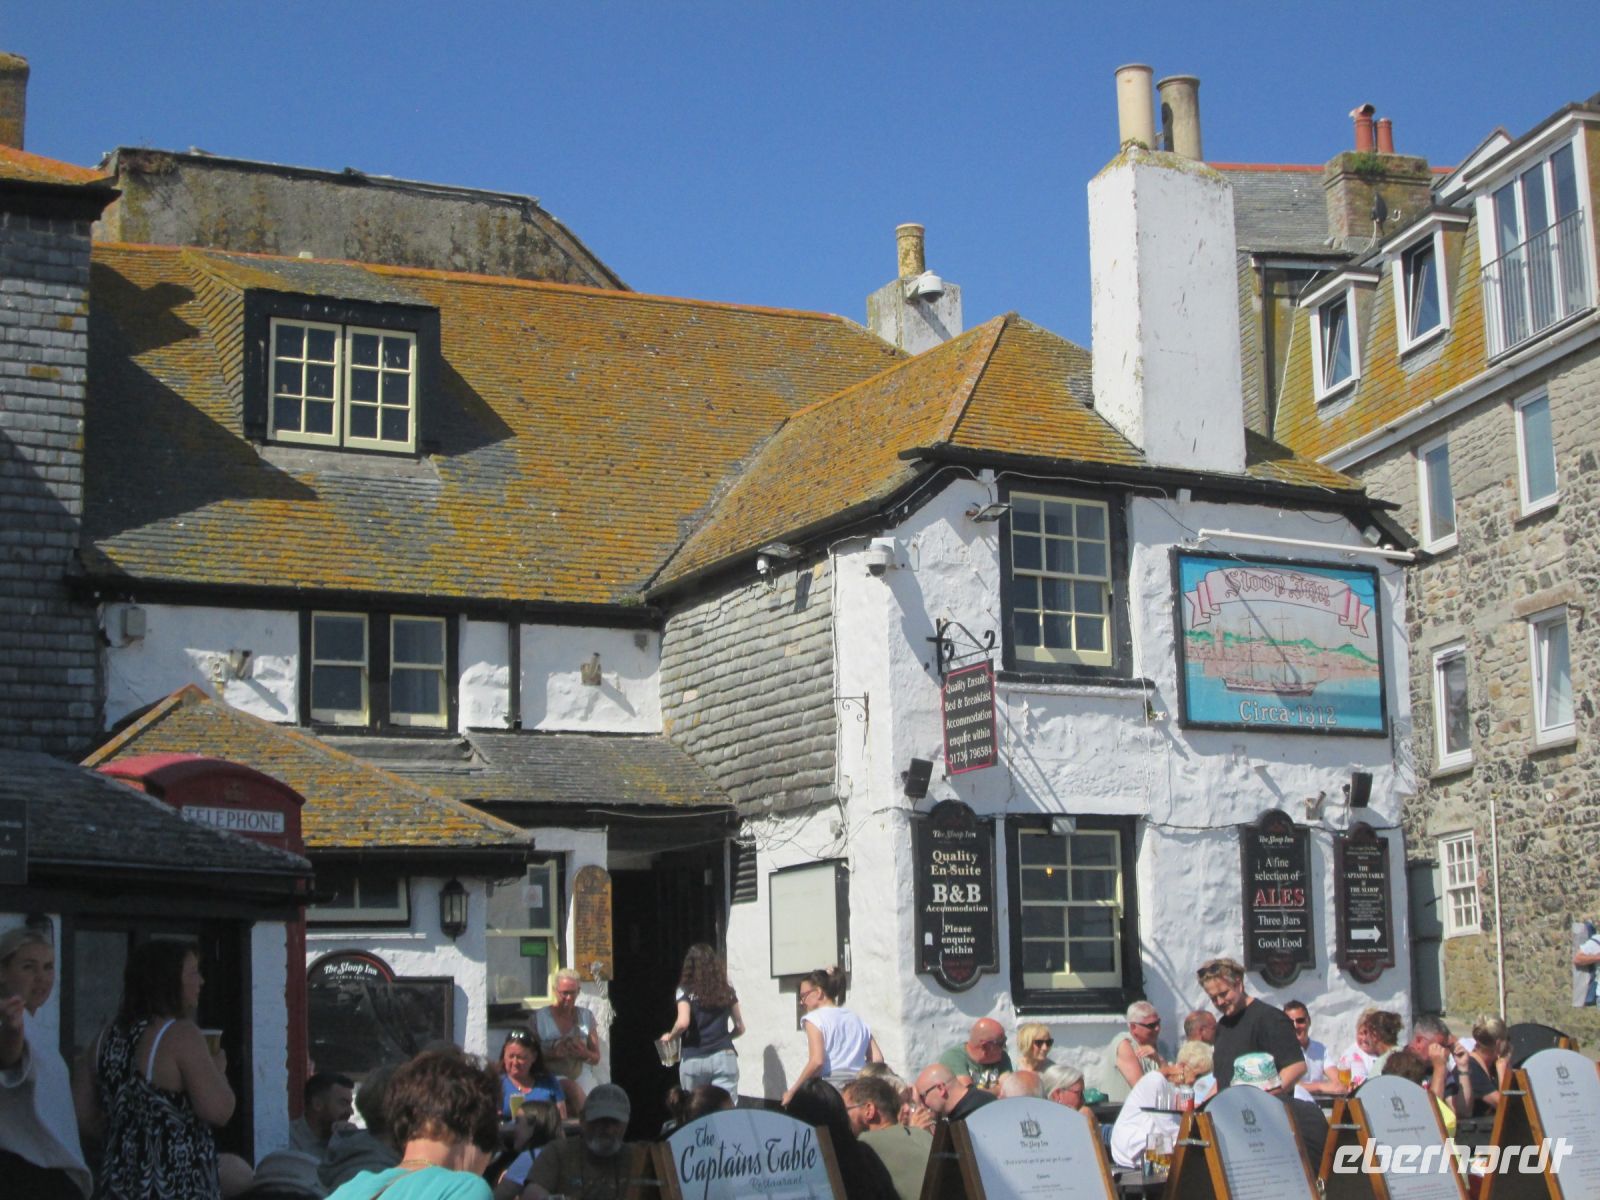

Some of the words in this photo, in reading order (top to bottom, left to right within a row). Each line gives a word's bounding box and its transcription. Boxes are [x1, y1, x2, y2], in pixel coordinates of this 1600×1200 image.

[1225, 569, 1285, 598] Sloop
[1289, 573, 1331, 606] Inn
[945, 680, 966, 694] Quality
[945, 699, 956, 712] Bed
[957, 698, 963, 709] &
[964, 691, 991, 707] Breakfast
[946, 710, 993, 730] Accommodation
[1239, 701, 1290, 722] Circa
[1296, 705, 1337, 725] 1312
[949, 731, 971, 748] enquire
[972, 728, 991, 741] within
[185, 808, 280, 830] TELEPHONE
[932, 850, 978, 864] Quality
[1265, 858, 1274, 867] A
[1275, 857, 1289, 867] fine
[930, 865, 982, 876] En-Suite
[1255, 871, 1288, 882] selection
[1290, 871, 1300, 881] of
[932, 883, 981, 903] B&B
[1253, 888, 1305, 907] ALES
[926, 904, 988, 913] Accommodation
[1258, 915, 1281, 926] Three
[1283, 915, 1301, 926] Bars
[944, 924, 972, 934] Please
[941, 936, 976, 946] enquire
[1258, 937, 1280, 949] Good
[1282, 937, 1302, 949] Food
[944, 945, 973, 955] within
[324, 964, 338, 975] The
[337, 962, 364, 975] Sloop
[364, 964, 378, 976] Inn
[695, 1121, 715, 1148] The
[680, 1140, 762, 1200] Captains
[765, 1127, 818, 1174] Table
[749, 1175, 802, 1193] Restaurant
